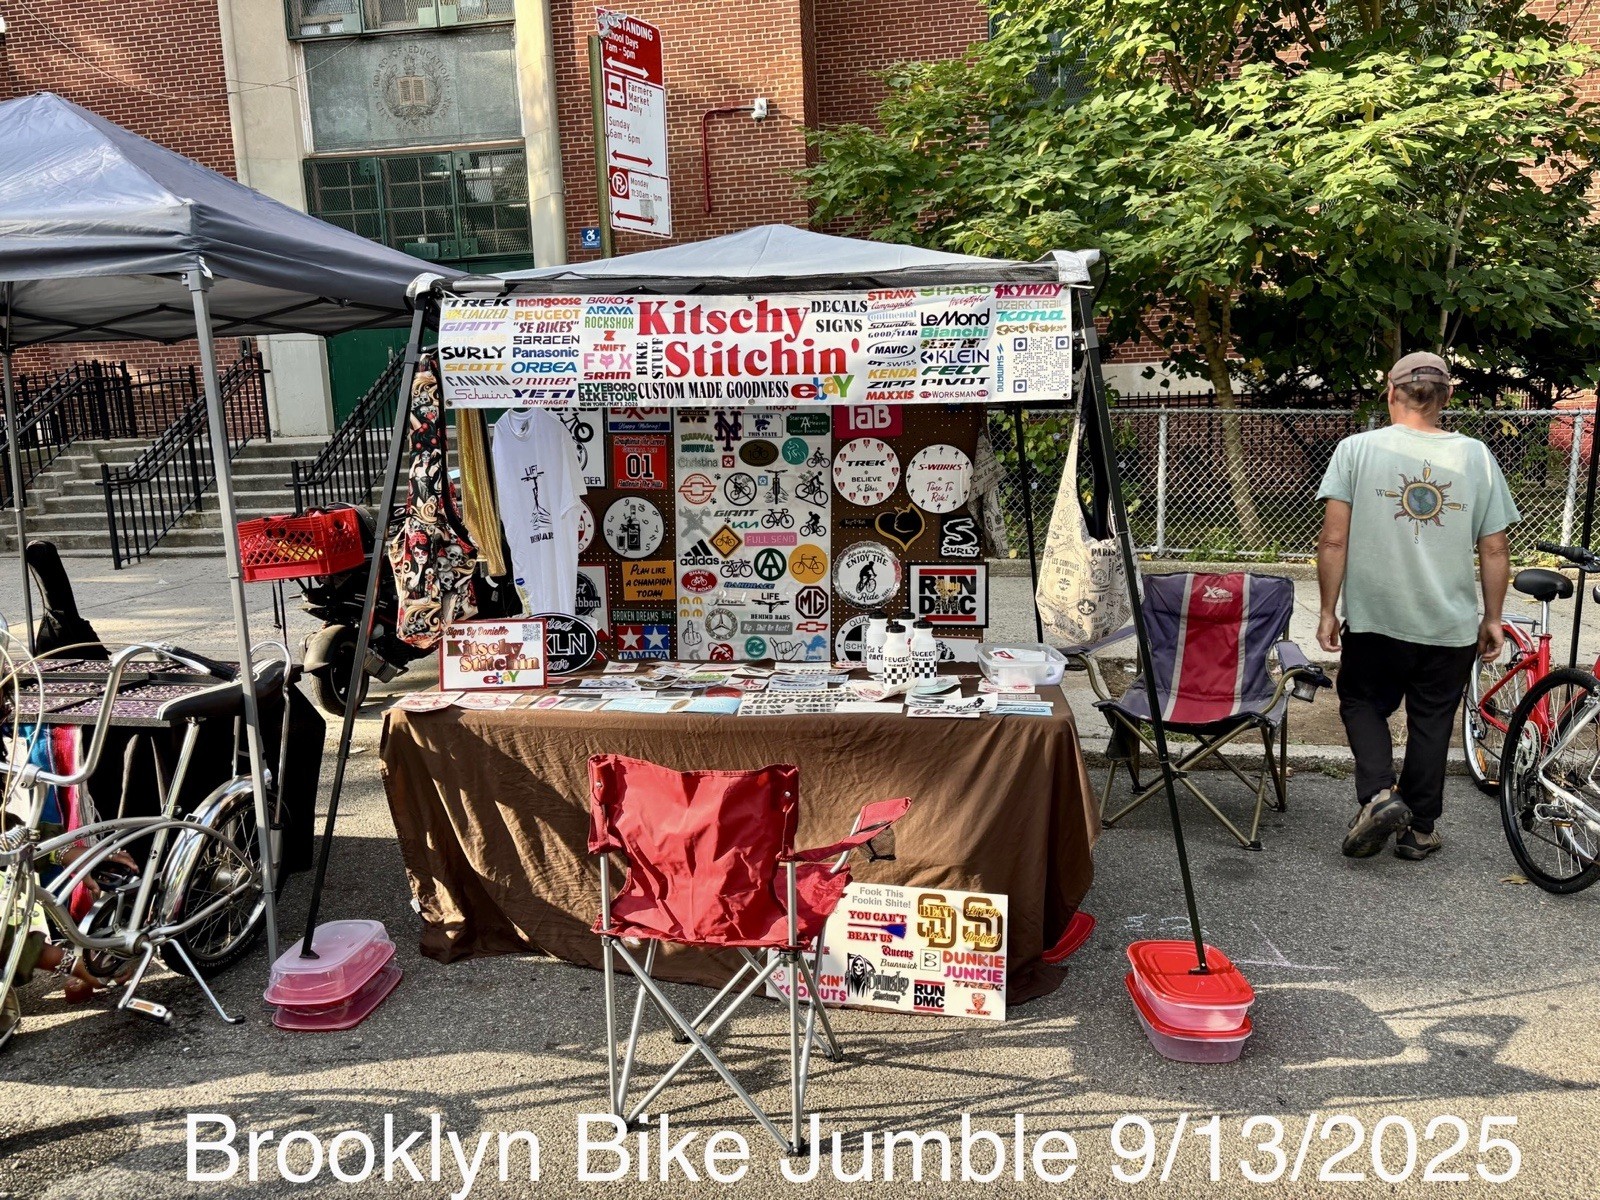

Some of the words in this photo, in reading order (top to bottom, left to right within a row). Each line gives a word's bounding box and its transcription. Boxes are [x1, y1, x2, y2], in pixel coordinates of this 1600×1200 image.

[617, 18, 653, 42] STANDING
[607, 30, 624, 44] chool
[625, 35, 639, 50] Days
[605, 40, 618, 54] 7am
[623, 46, 636, 60] 5pm
[628, 81, 653, 98] Farmers
[628, 92, 650, 106] Market
[628, 102, 643, 117] Only
[608, 116, 631, 131] Sunday
[609, 129, 623, 140] 6am
[628, 133, 641, 145] 6pm
[630, 178, 649, 190] Monday
[867, 289, 917, 301] STRAVA
[935, 285, 991, 296] HARO
[994, 283, 1065, 299] SKYWAY
[448, 298, 513, 308] TREK
[515, 297, 582, 308] mongoose
[585, 296, 625, 305] BRIKO
[586, 306, 634, 315] ARAYA
[811, 299, 868, 315] DECALS
[514, 309, 581, 321] PEUGEOT
[637, 299, 811, 342] Kitschy
[867, 310, 917, 322] Continental
[921, 308, 990, 327] LeMond
[441, 321, 506, 332] GIANT
[584, 316, 634, 330] ROCKSHOX
[815, 318, 863, 333] SIGNS
[921, 327, 989, 338] Bianchi
[440, 345, 507, 361] SURLY
[512, 347, 579, 358] Panasonic
[593, 344, 627, 352] ZWIFT
[874, 344, 909, 355] MAVIC
[636, 341, 648, 376] BIKE
[651, 337, 664, 379] STUFF
[665, 338, 860, 378] Stitchin'
[935, 349, 990, 364] KLEIN
[443, 362, 507, 373] SCOTT
[511, 361, 577, 374] ORBEA
[886, 359, 917, 367] SWISS
[583, 371, 631, 380] SRAM
[867, 368, 918, 379] KENDA
[921, 365, 990, 376] FELT
[997, 355, 1005, 393] SHIMANO
[445, 375, 511, 387] CANYON
[867, 380, 916, 389] ZIPP
[921, 377, 990, 386] PIVOT
[445, 388, 513, 400] Schwinn
[512, 389, 577, 399] YETI
[637, 381, 685, 400] CUSTOM
[688, 381, 724, 400] MADE
[726, 380, 789, 399] GOODNESS
[866, 390, 915, 401] MAXXIS
[932, 390, 977, 399] WORKSMAN
[625, 453, 654, 479] 01
[846, 459, 887, 467] TREK
[918, 463, 963, 471] S-WORKS
[1423, 459, 1432, 467] N
[1375, 488, 1385, 497] W
[713, 509, 759, 517] GIANT
[1461, 503, 1468, 512] E
[770, 534, 795, 543] SEND
[942, 546, 979, 556] SURLY
[1091, 548, 1116, 557] PARIS
[680, 555, 720, 566] adidas
[845, 553, 870, 569] ENJOY
[872, 554, 889, 567] THE
[633, 578, 672, 586] CHAMPION
[761, 592, 780, 600] LIFE
[857, 591, 880, 602] Ride
[574, 597, 601, 608] ibbon
[919, 595, 977, 614] DMC
[612, 610, 634, 621] BROKEN
[636, 611, 659, 621] DREAMS
[467, 626, 476, 638] By
[447, 638, 524, 658] Kitschy
[620, 651, 669, 660] TAMIYA
[459, 653, 540, 672] Stitchin
[859, 886, 882, 896] Fook
[885, 888, 904, 898] This
[852, 895, 884, 905] Fookin
[885, 898, 911, 909] Shite!
[848, 910, 871, 920] YOU
[873, 911, 907, 923] CAN'T
[919, 904, 954, 918] BEAT
[847, 930, 880, 942] BEAT
[881, 933, 894, 944] US
[964, 931, 1002, 947] Padres!
[881, 945, 915, 961] Queens
[880, 958, 918, 970] Brunswick
[942, 950, 1006, 969] DUNKIE
[943, 965, 1005, 983] JUNKIE
[914, 983, 945, 997] RUN
[952, 979, 1005, 992] TREK
[913, 995, 945, 1008] DMC
